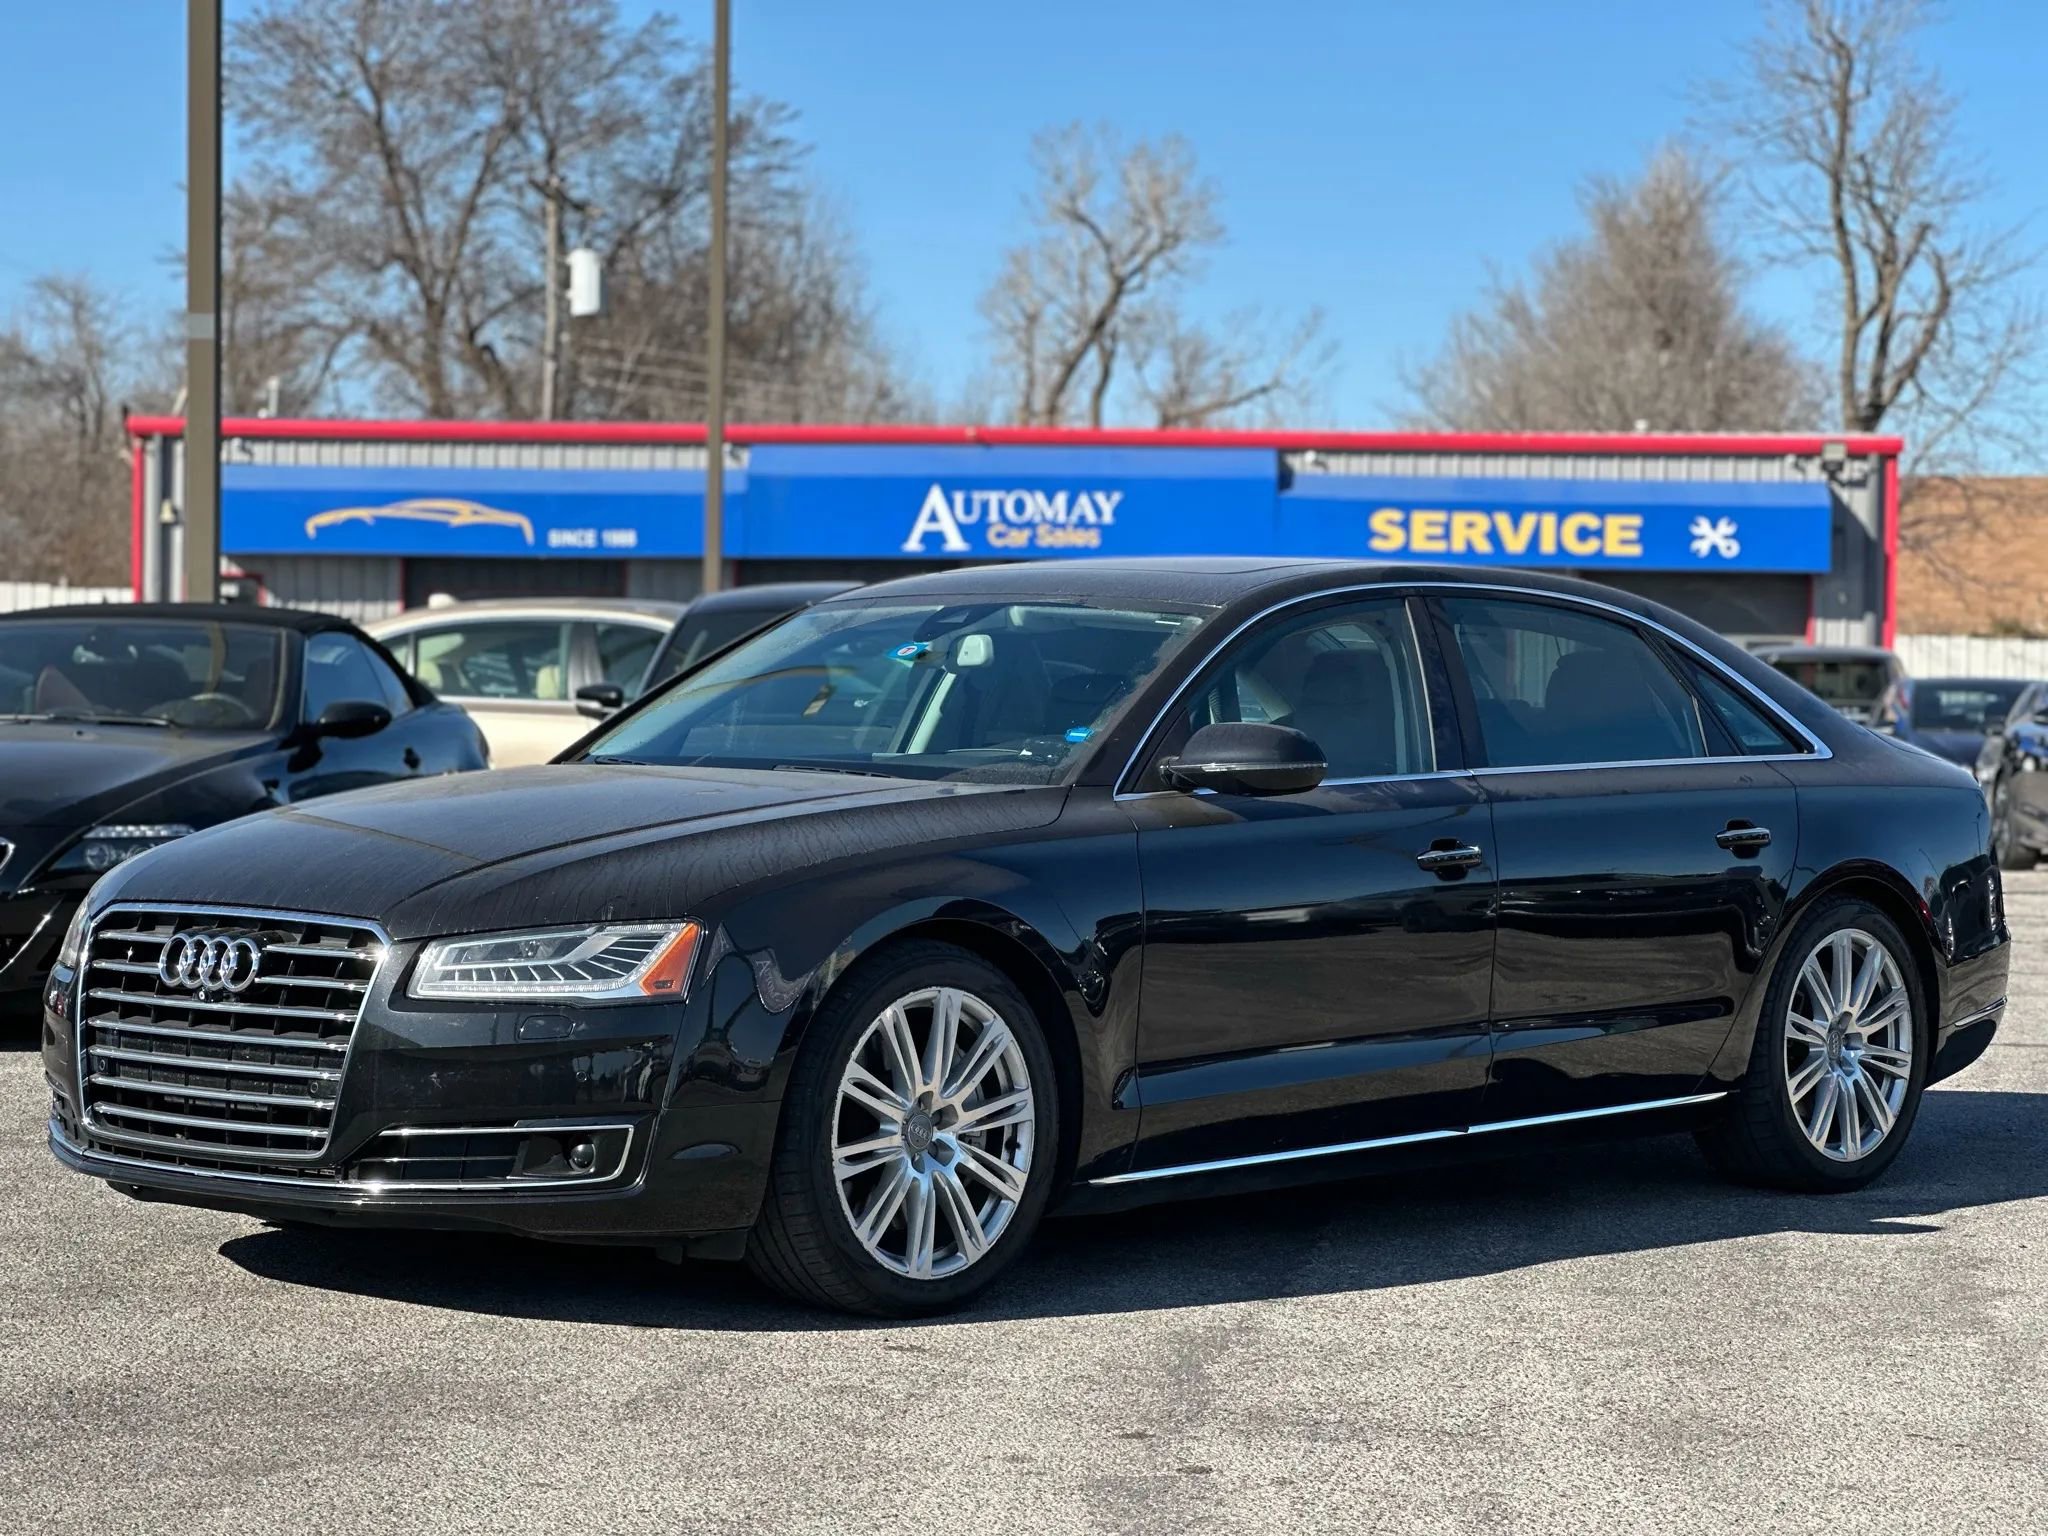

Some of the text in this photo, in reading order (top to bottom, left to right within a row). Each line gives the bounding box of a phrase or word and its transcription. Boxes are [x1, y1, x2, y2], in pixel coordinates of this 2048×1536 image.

[902, 484, 1122, 552] AUTOMAY
[986, 523, 1101, 549] Car Sales
[1369, 508, 1643, 557] SERVICE
[547, 528, 598, 549] SINCE
